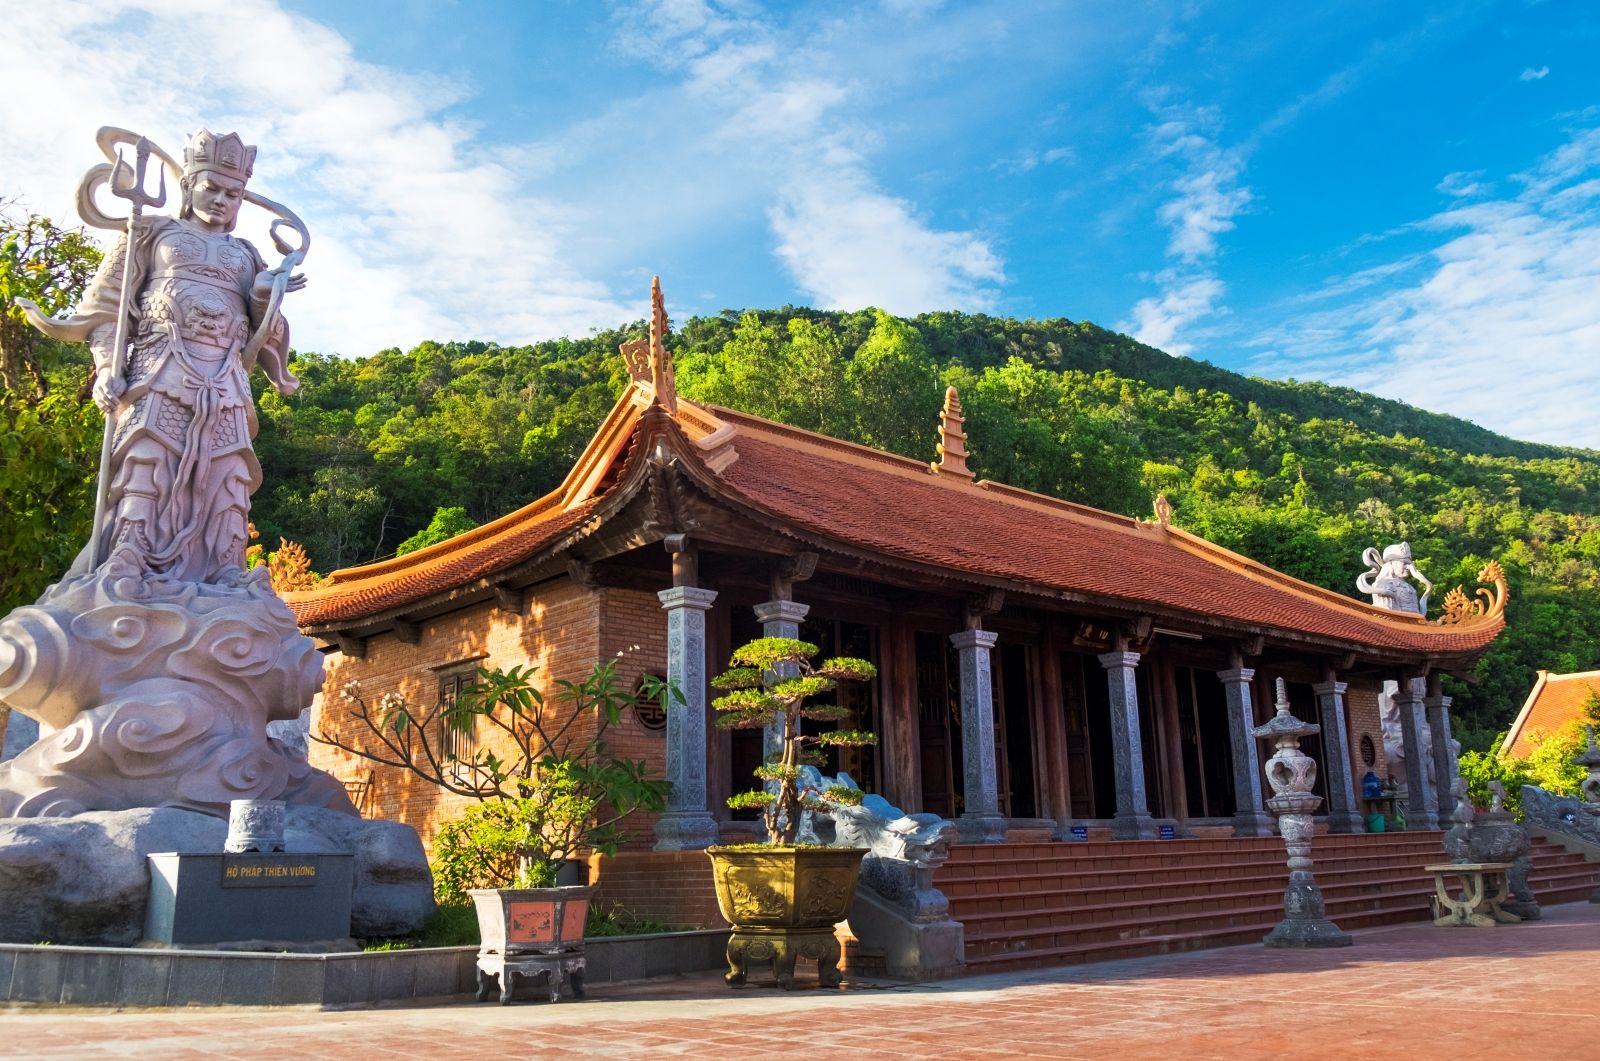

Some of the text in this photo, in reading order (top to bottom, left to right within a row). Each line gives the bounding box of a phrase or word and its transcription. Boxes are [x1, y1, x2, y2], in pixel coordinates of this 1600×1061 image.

[226, 865, 316, 878] HỘ PHÁP THIÊN VƯƠNG
